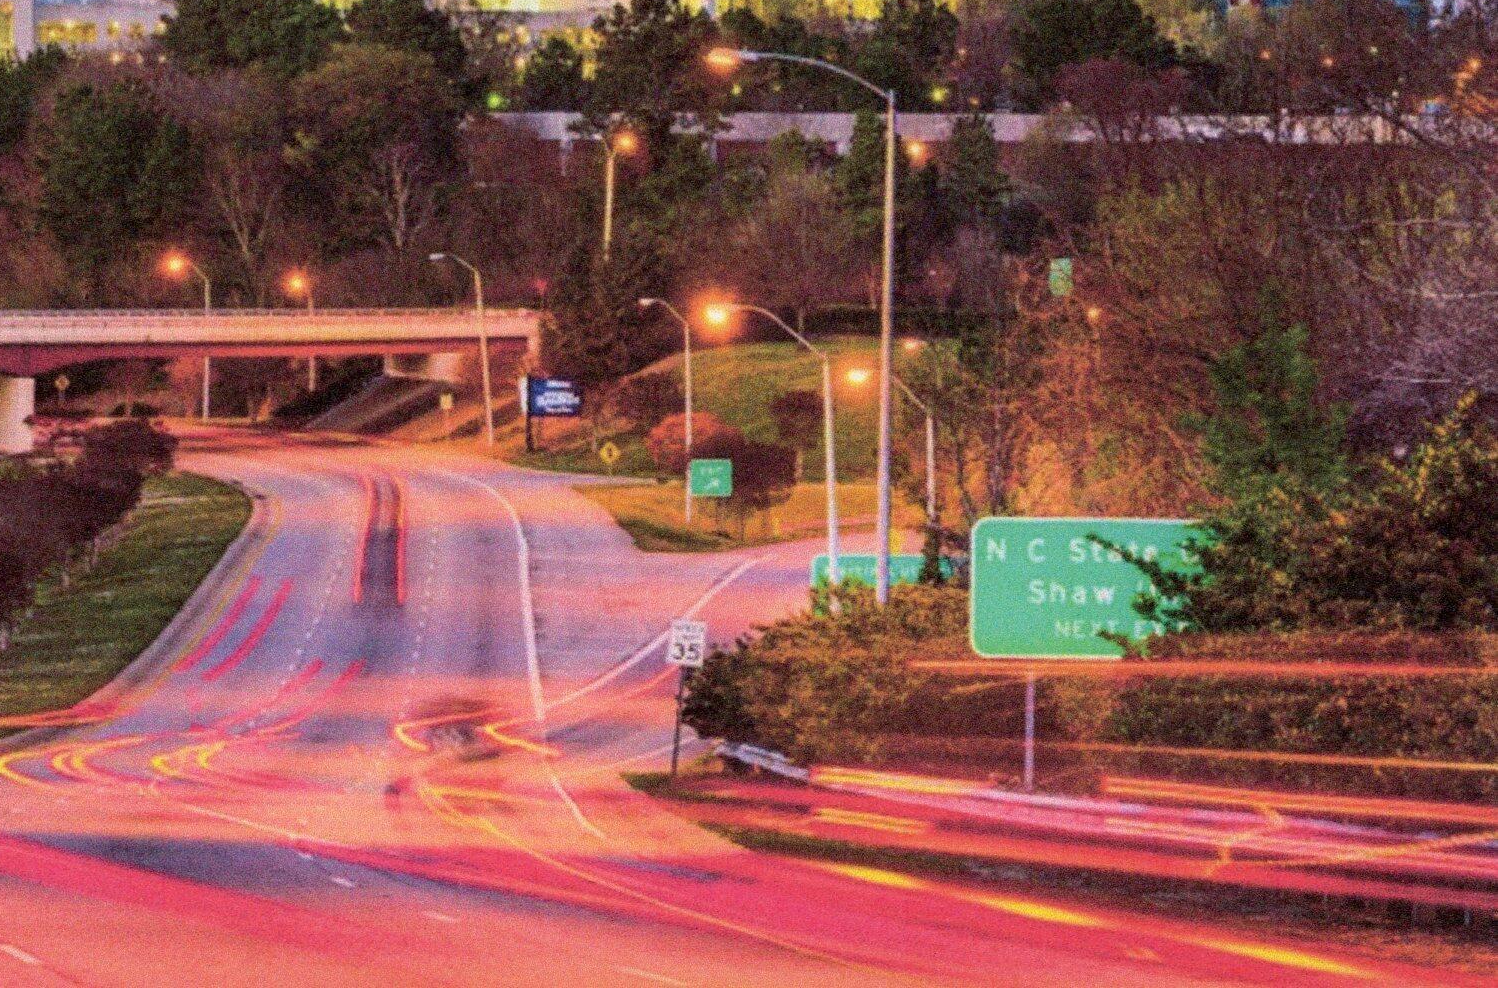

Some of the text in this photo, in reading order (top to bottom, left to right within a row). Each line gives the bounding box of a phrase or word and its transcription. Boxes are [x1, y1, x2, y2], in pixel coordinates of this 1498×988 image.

[986, 538, 1007, 562] N
[1027, 538, 1047, 562] C
[1028, 579, 1115, 605] Shaw
[1054, 620, 1119, 639] NEXT
[672, 642, 701, 662] 35
